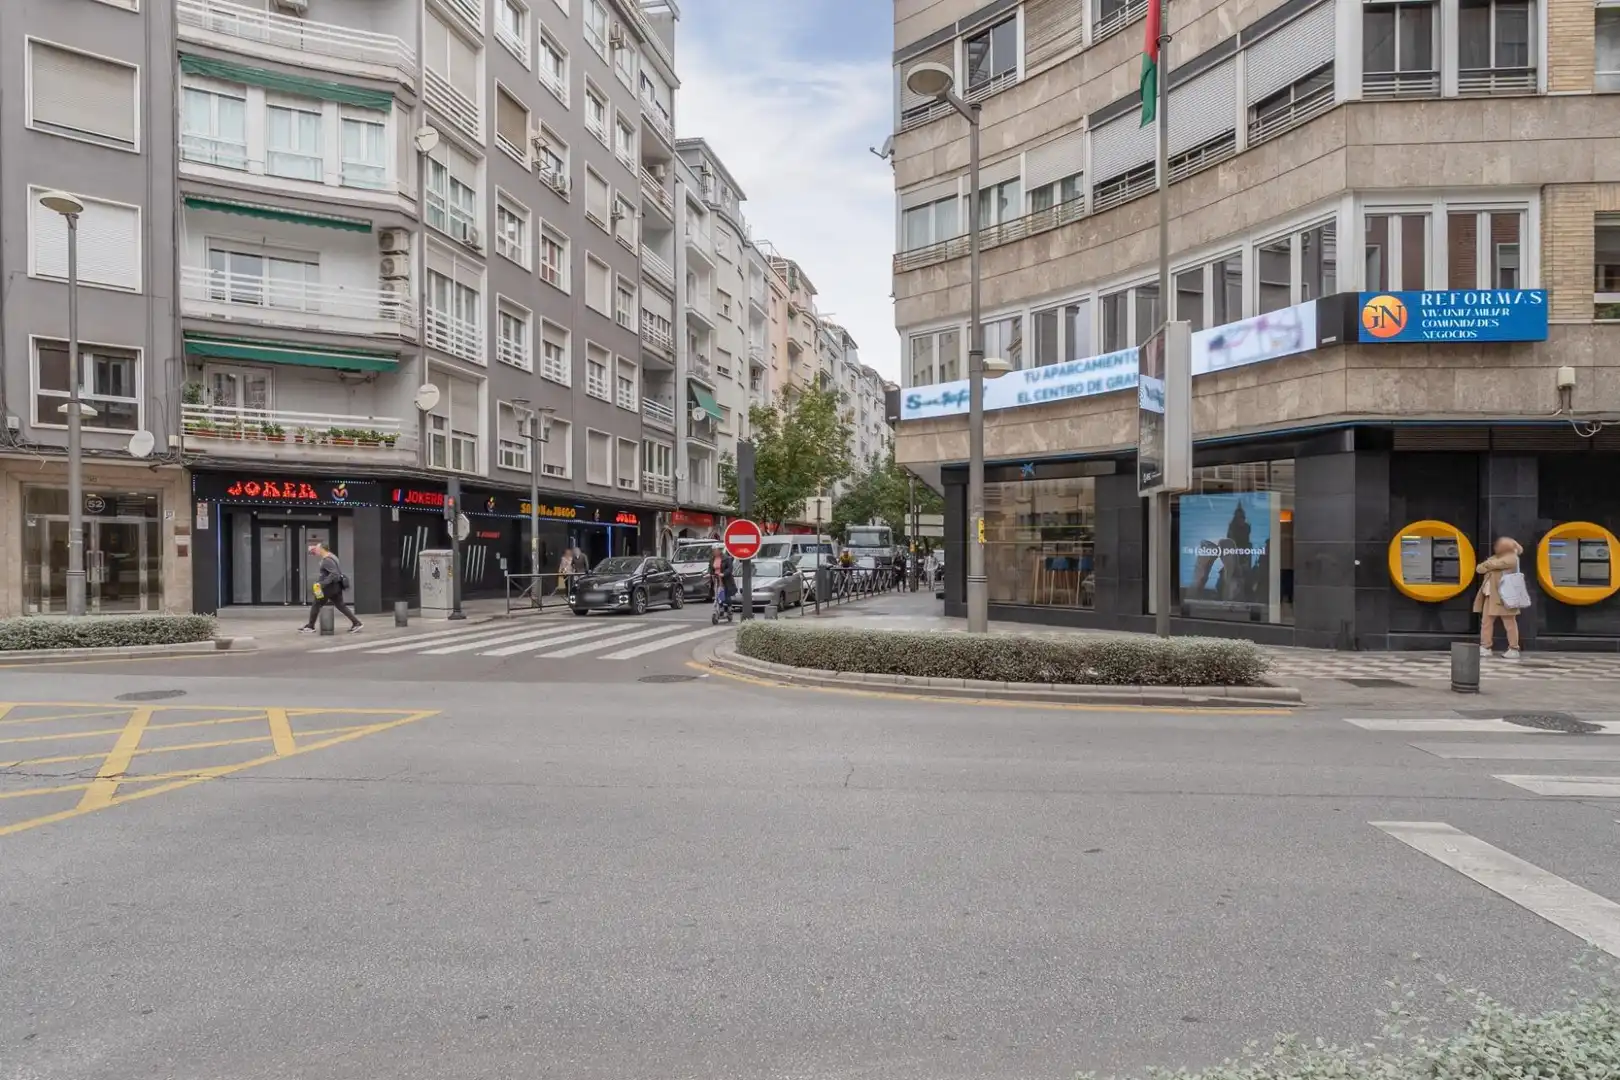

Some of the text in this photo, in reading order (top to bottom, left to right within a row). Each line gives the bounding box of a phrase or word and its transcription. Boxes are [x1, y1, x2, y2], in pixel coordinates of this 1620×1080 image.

[1421, 291, 1542, 306] REFORMAS
[1421, 318, 1500, 328] COMUNIDADES
[1422, 330, 1478, 339] NEGOCIOS
[1024, 371, 1040, 383] TU
[1033, 383, 1084, 400] CENTRO
[1087, 380, 1104, 393] DE
[227, 481, 318, 499] JOKER
[88, 500, 103, 508] 52
[1223, 547, 1266, 556] personal
